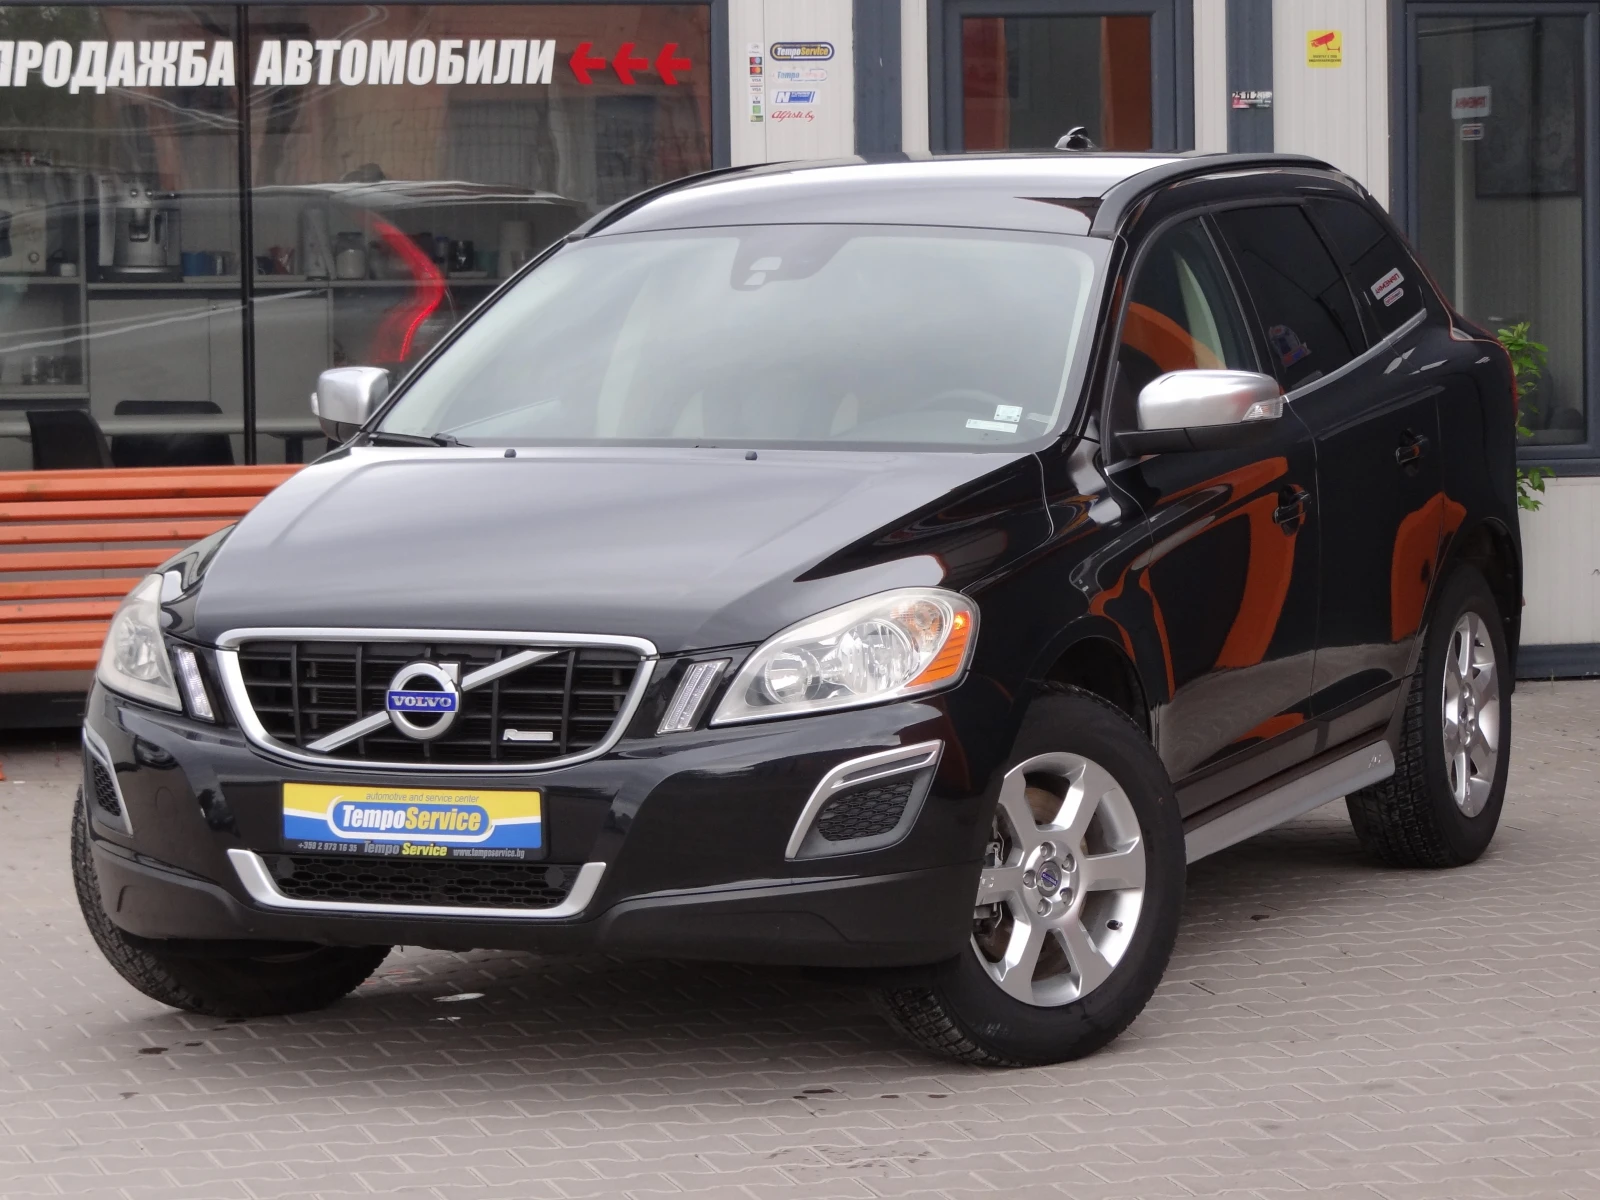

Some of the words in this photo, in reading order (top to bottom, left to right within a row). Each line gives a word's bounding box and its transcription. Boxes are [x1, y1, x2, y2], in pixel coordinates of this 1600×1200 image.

[253, 39, 556, 86] АВТОМОБИЛИ
[392, 696, 452, 708] VOLVO
[366, 792, 407, 802] automotive
[409, 794, 424, 802] and
[425, 794, 453, 803] service
[454, 795, 479, 803] center
[342, 805, 482, 831] TempoService
[323, 843, 337, 851] 973
[339, 844, 347, 852] 16
[363, 840, 400, 855] Tempo
[402, 842, 448, 856] Service
[452, 848, 525, 859] www.temposervice.bg
